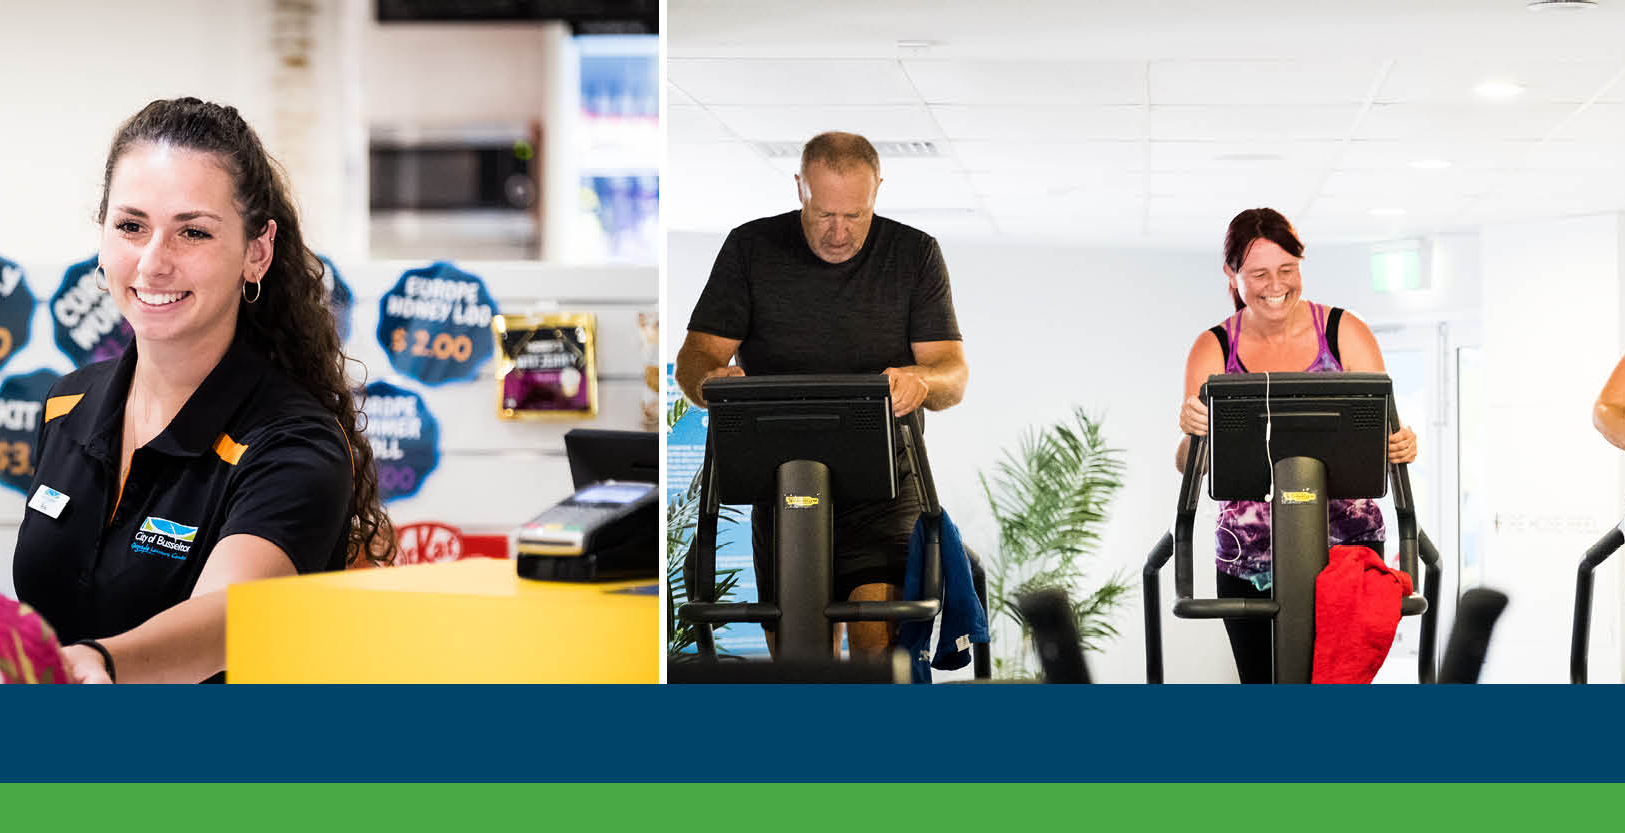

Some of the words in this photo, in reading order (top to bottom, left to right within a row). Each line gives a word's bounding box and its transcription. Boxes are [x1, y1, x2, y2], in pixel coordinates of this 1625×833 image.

[405, 276, 479, 304] EUROPE
[386, 295, 452, 323] HONEY
[135, 531, 149, 545] City
[148, 534, 158, 544] of
